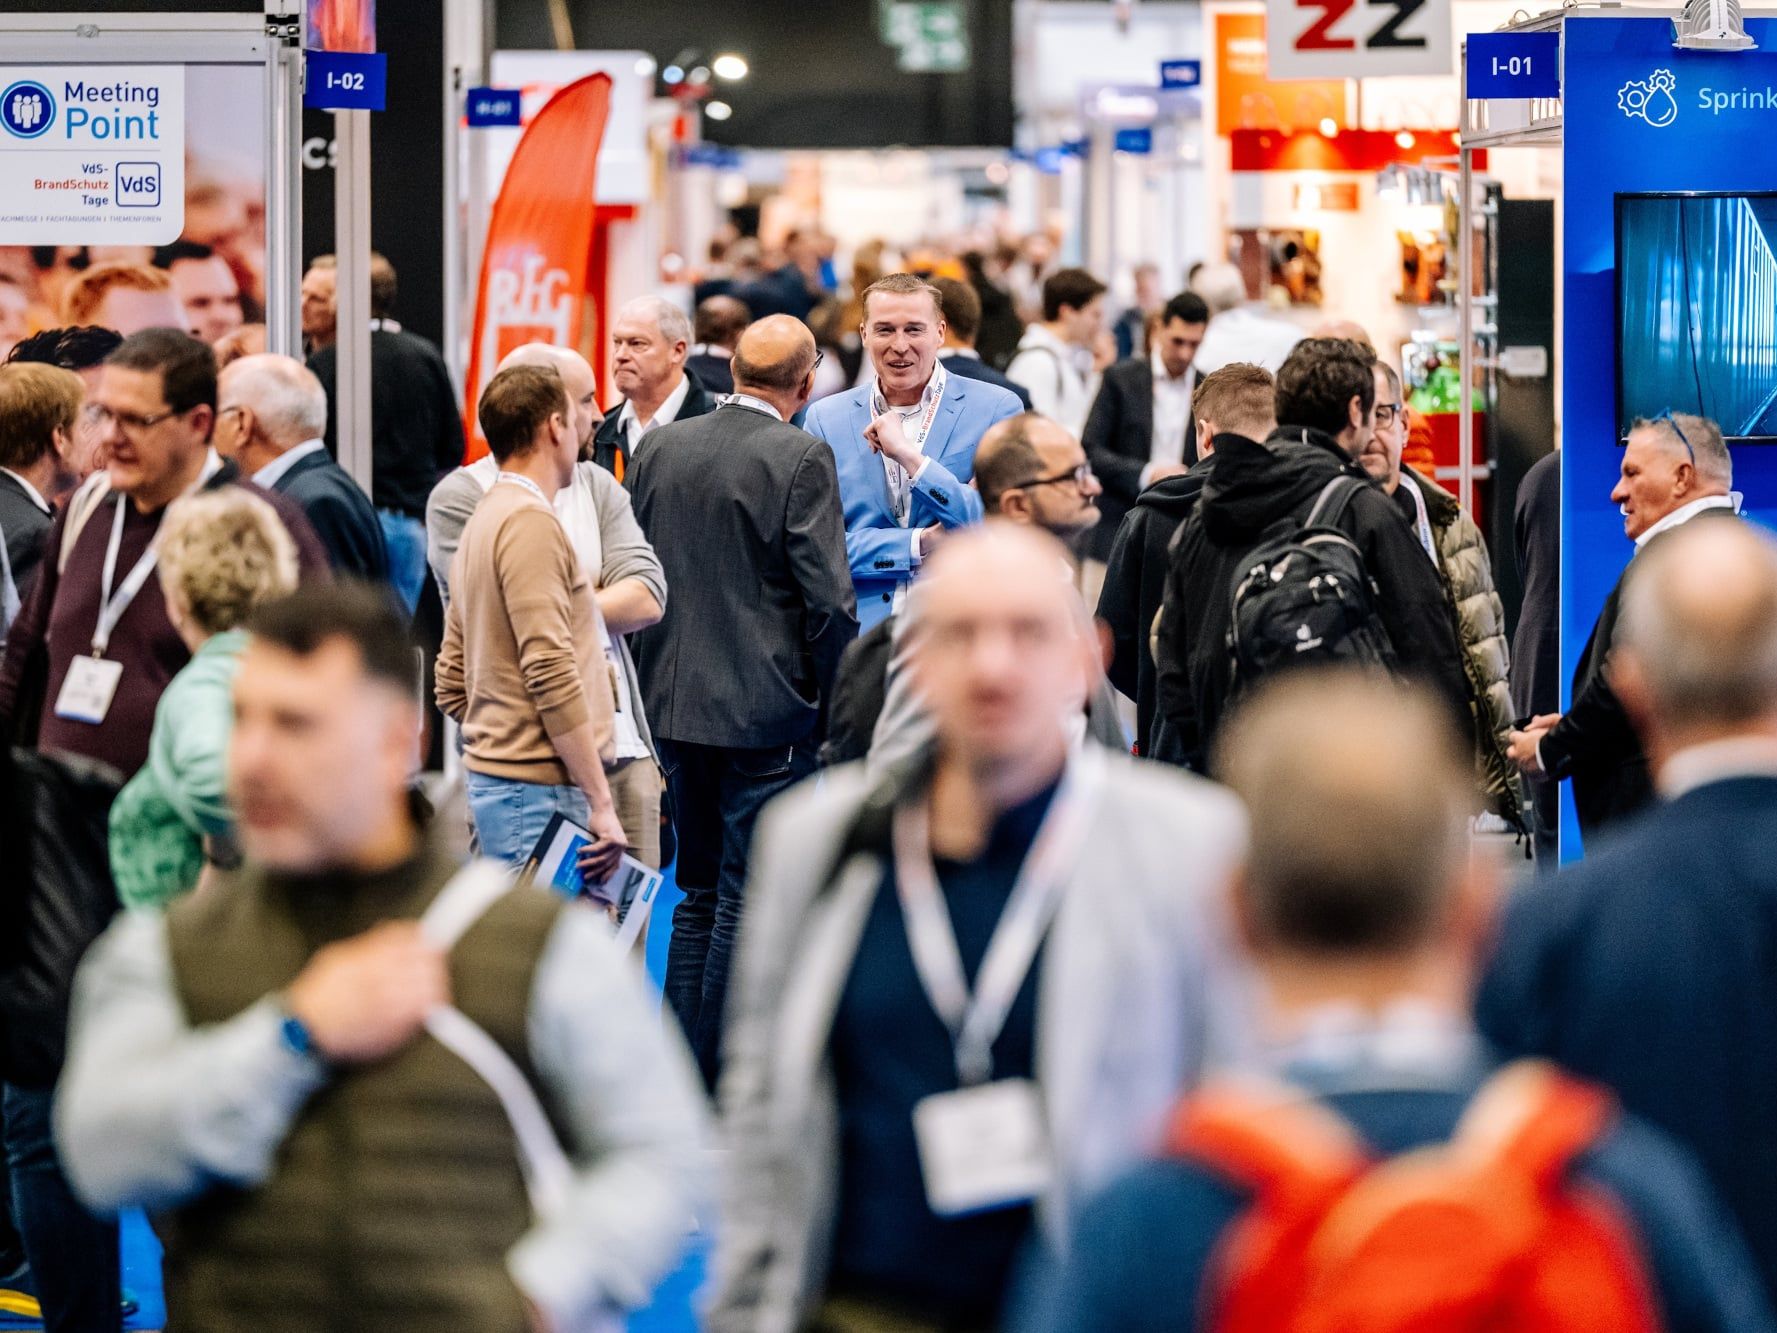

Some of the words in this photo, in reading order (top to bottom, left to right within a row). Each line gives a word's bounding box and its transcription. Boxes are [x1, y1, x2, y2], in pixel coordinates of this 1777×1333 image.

[1491, 56, 1533, 76] I-01
[326, 71, 365, 91] I-02
[65, 81, 159, 108] Meeting
[1698, 86, 1777, 115] Sprink
[66, 107, 159, 140] Point
[82, 163, 109, 175] VdS-
[34, 179, 109, 190] BrandSchutz
[120, 176, 157, 193] VdS
[82, 194, 109, 207] Tage
[0, 215, 38, 223] ACHMESSE
